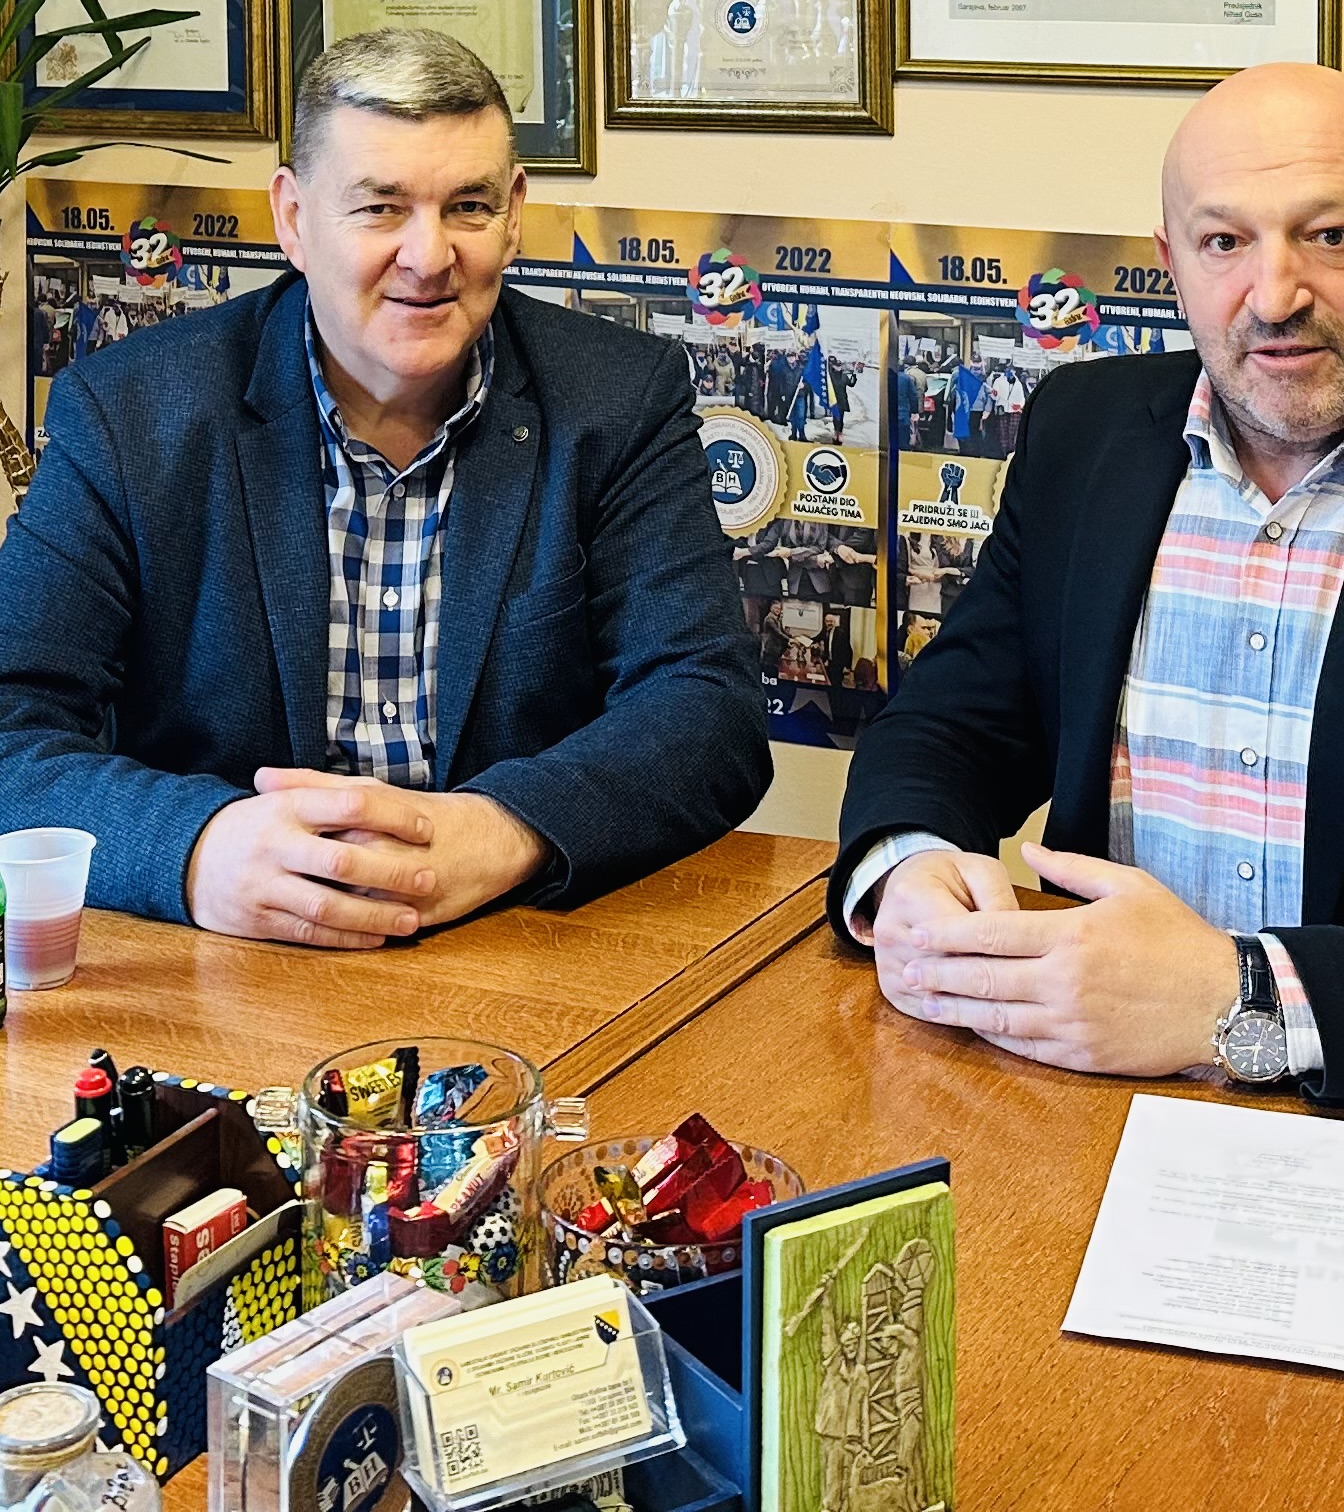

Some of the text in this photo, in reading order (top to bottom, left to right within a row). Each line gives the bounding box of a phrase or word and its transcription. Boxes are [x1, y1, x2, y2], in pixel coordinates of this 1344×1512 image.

[61, 206, 239, 239] 18.05. 2022
[131, 232, 168, 270] 32
[617, 237, 832, 274] 18.05. 2022
[938, 255, 1008, 284] 18.05.
[698, 265, 745, 308] 32
[1029, 288, 1080, 331] 32
[902, 514, 945, 526] ZAJEDNO
[947, 519, 968, 528] SMO
[913, 504, 968, 517] PRIDRUŽI SE
[506, 1377, 532, 1392] Samir
[535, 1363, 576, 1382] Kurtović
